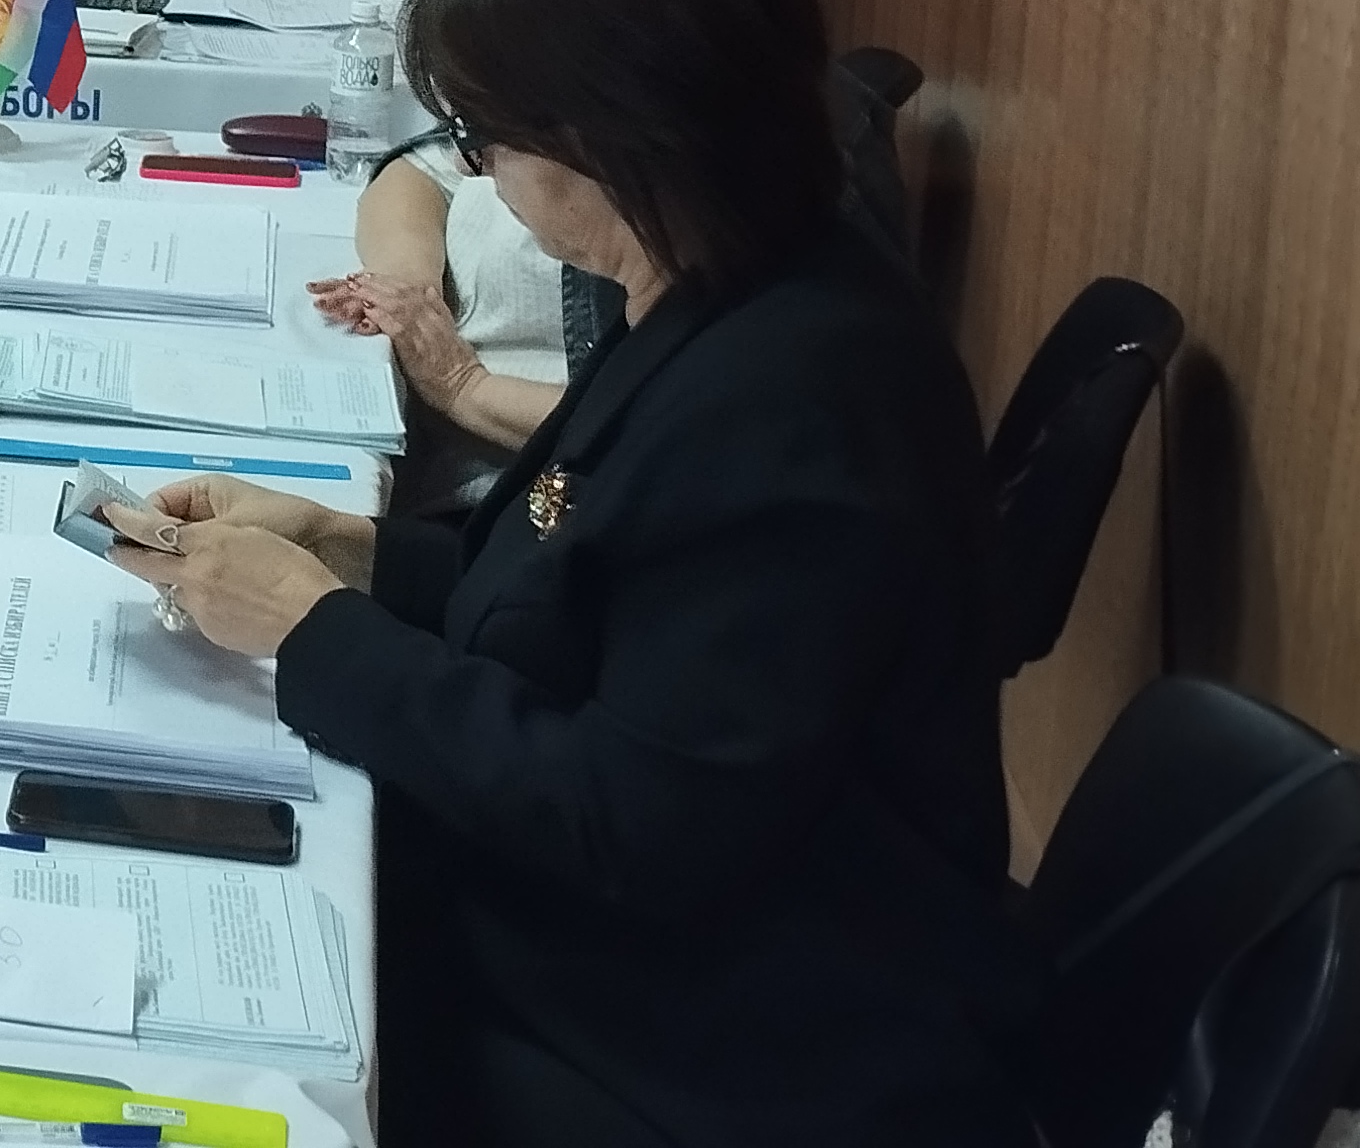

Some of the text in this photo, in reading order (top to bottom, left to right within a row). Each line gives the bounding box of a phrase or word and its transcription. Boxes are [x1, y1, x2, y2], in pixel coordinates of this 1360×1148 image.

[342, 53, 380, 71] ТОЛЬКО
[340, 69, 372, 87] ВОДА
[3, 577, 32, 640] ИЗБИРАТЕЛЕЙ
